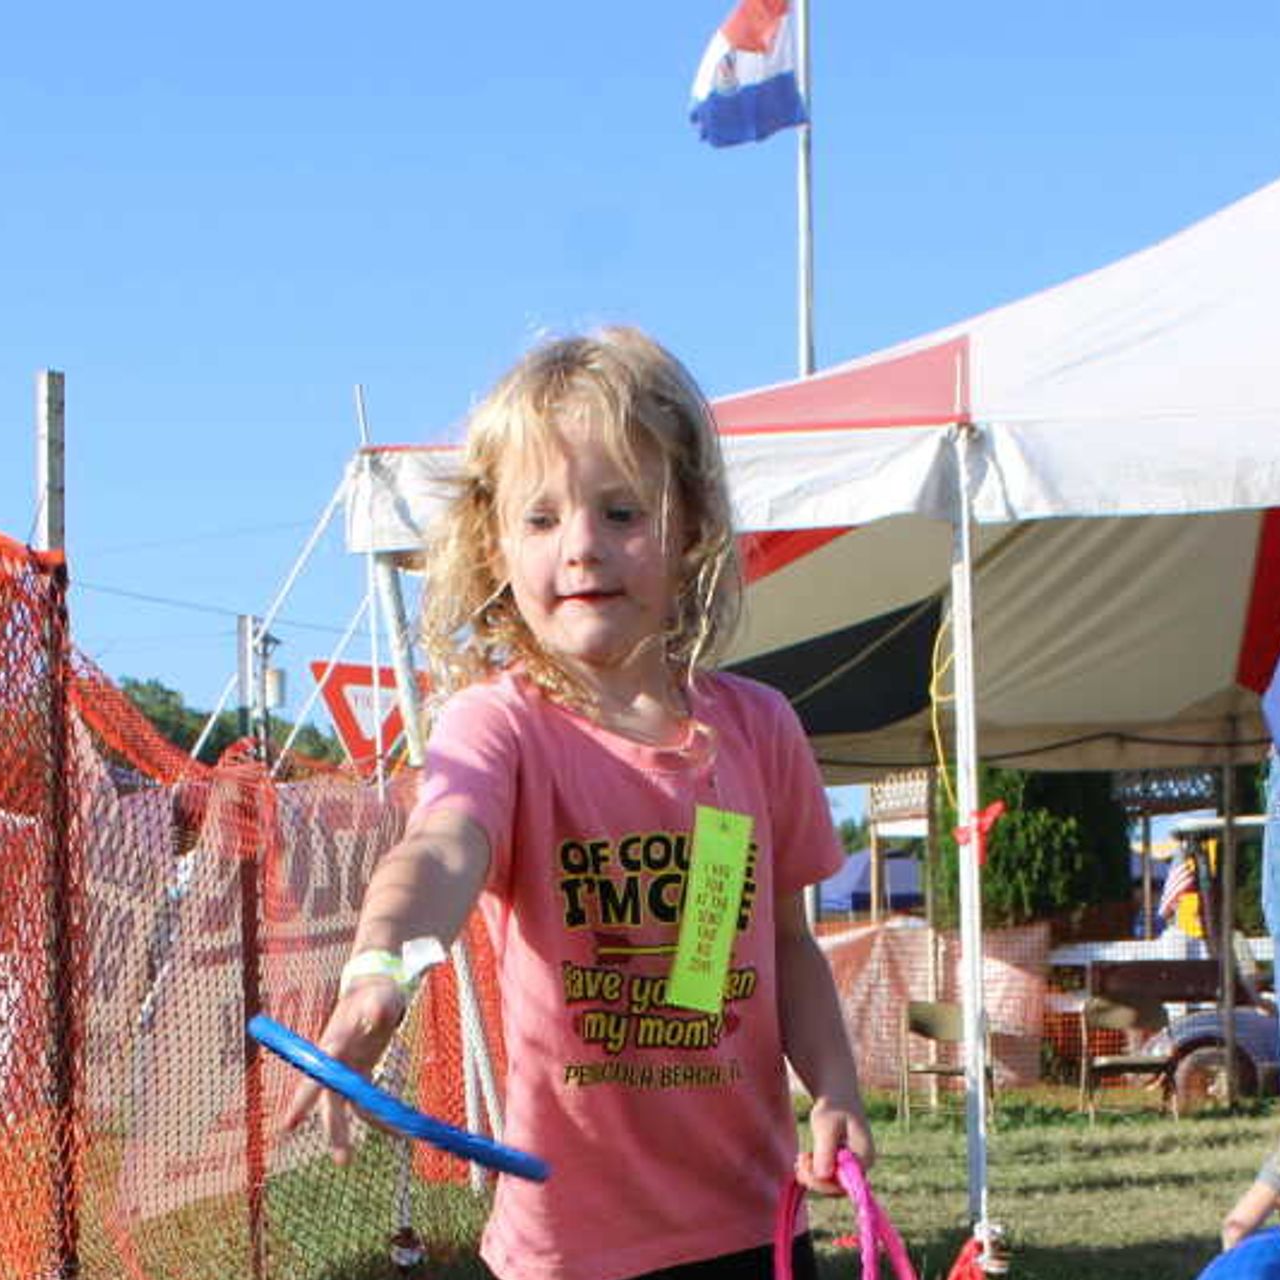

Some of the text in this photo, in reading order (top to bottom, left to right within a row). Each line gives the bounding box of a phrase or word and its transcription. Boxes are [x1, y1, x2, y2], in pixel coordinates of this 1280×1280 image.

[561, 841, 610, 875] OF
[561, 875, 642, 927] I'M
[630, 973, 671, 1012] yo
[581, 1009, 630, 1054] my
